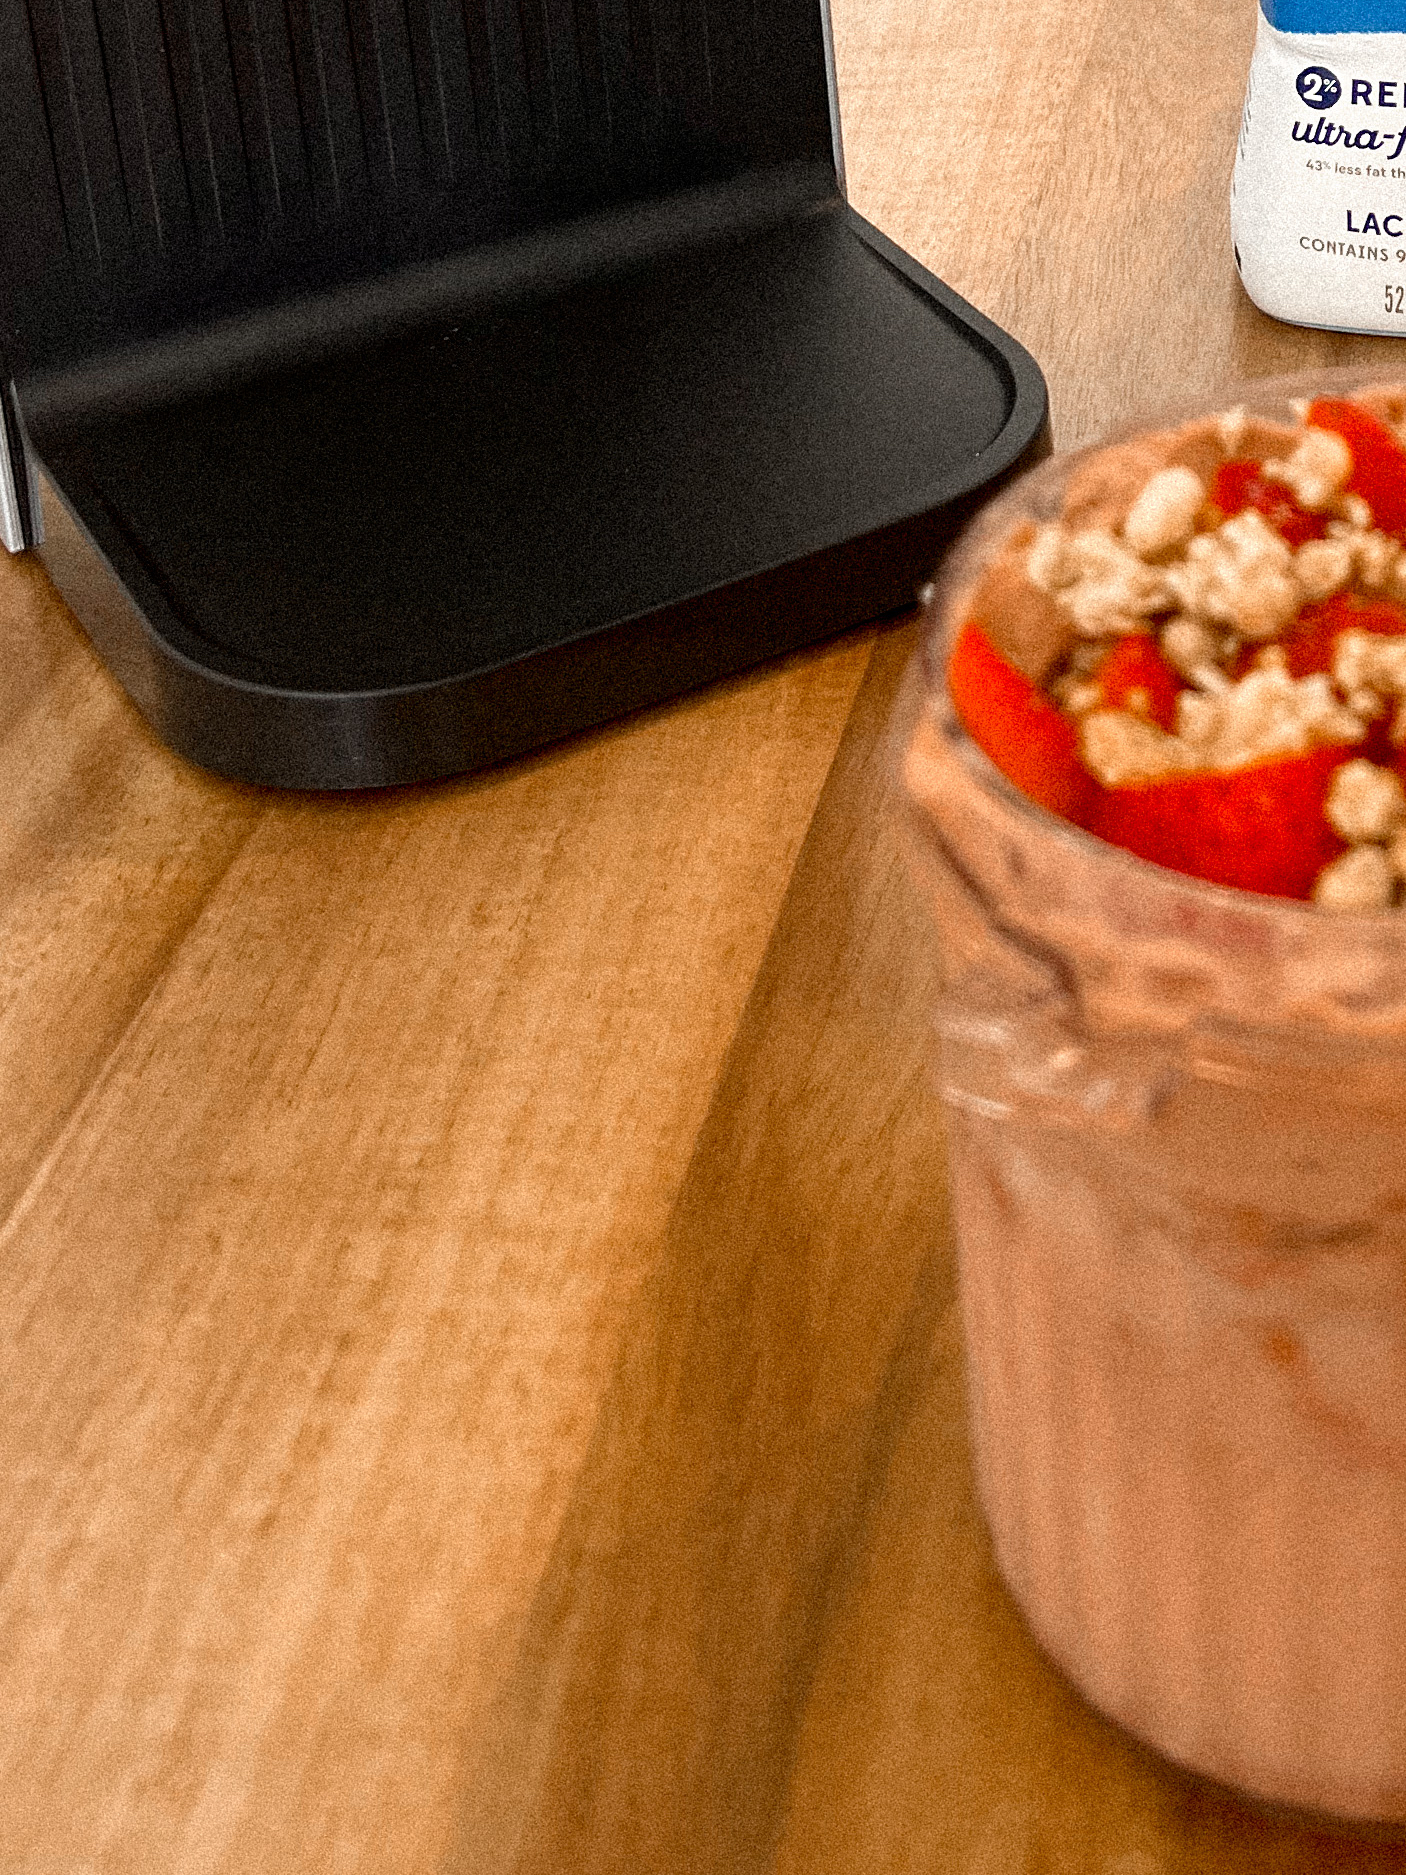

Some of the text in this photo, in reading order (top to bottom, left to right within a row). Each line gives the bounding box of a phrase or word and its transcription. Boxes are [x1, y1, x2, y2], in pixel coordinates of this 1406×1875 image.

[1302, 72, 1338, 102] 2%
[1305, 158, 1332, 172] 43%
[1335, 162, 1362, 176] less
[1366, 165, 1387, 178] fat
[1299, 236, 1389, 262] CONTAINS
[1395, 249, 1406, 263] 9
[1384, 284, 1405, 314] 52
